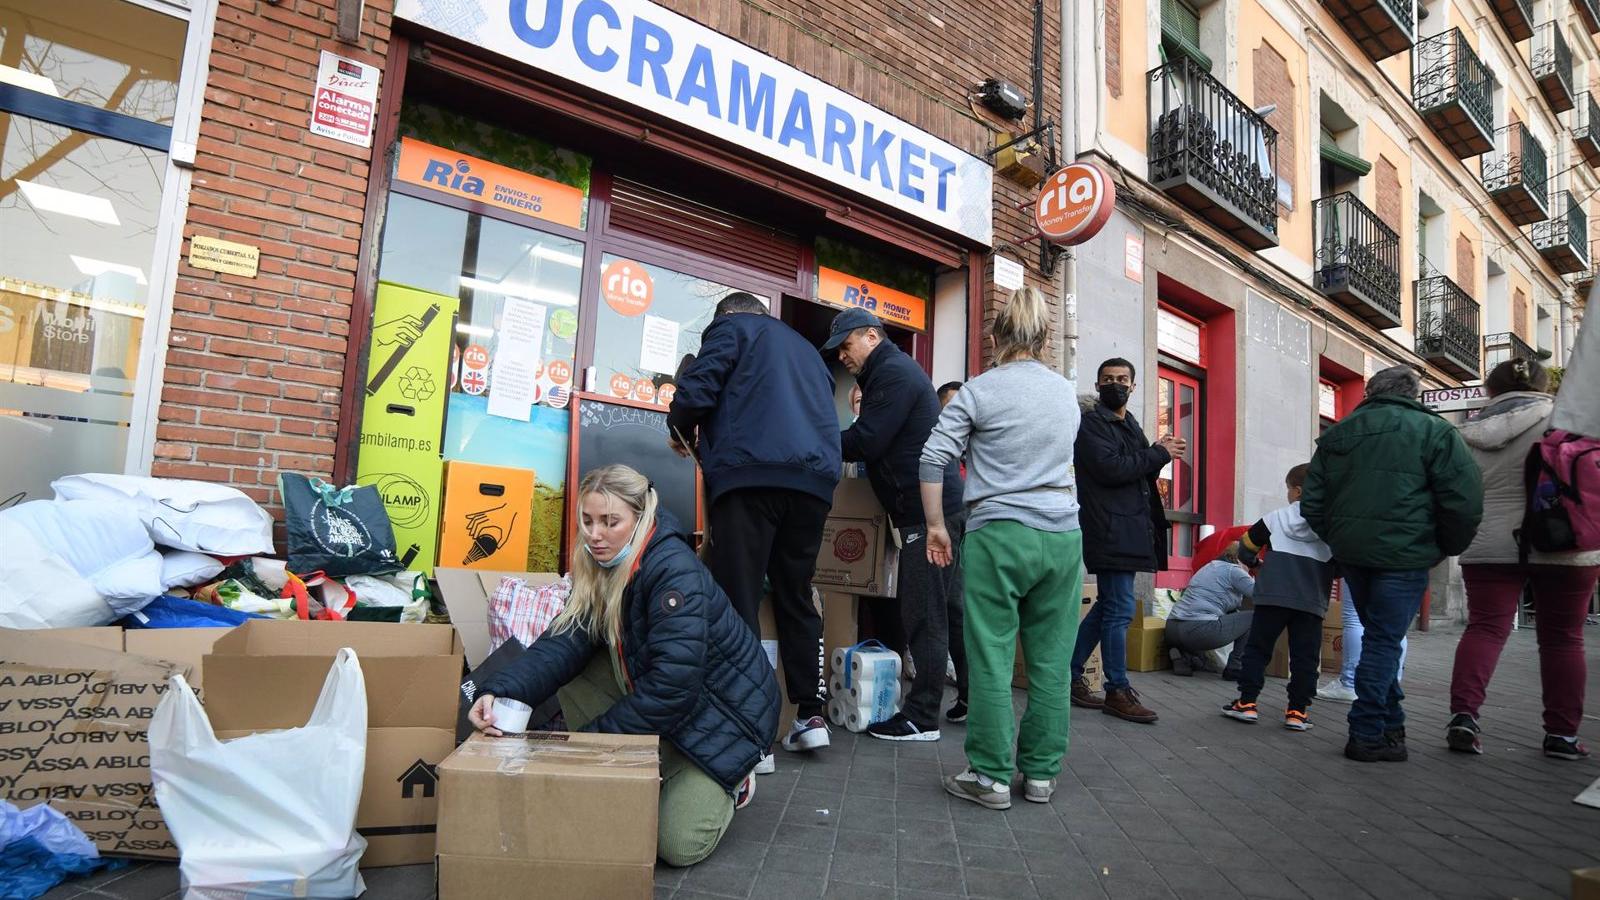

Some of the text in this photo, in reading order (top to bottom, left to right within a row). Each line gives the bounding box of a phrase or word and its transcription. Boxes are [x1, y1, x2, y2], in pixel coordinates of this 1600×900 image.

[319, 100, 369, 121] conectada
[320, 91, 370, 113] Alarma
[509, 0, 956, 212] UCRAMARKET
[423, 159, 485, 196] Ria
[494, 192, 542, 213] DINERO
[495, 184, 543, 204] ENVIOS DE
[1040, 173, 1093, 217] ria
[1039, 216, 1064, 228] Money
[608, 267, 648, 299] ria
[843, 284, 878, 311] Ria
[883, 302, 911, 315] MONEY
[43, 325, 89, 344] Store
[465, 348, 486, 360] ria
[550, 363, 569, 376] ria
[613, 377, 631, 391] ria
[637, 383, 653, 395] ria
[360, 433, 431, 451] ambilamp.es
[21, 672, 95, 686] ABLOY
[62, 706, 120, 720] ASSA
[22, 757, 88, 773] ASSA
[65, 810, 139, 822] ABLOY
